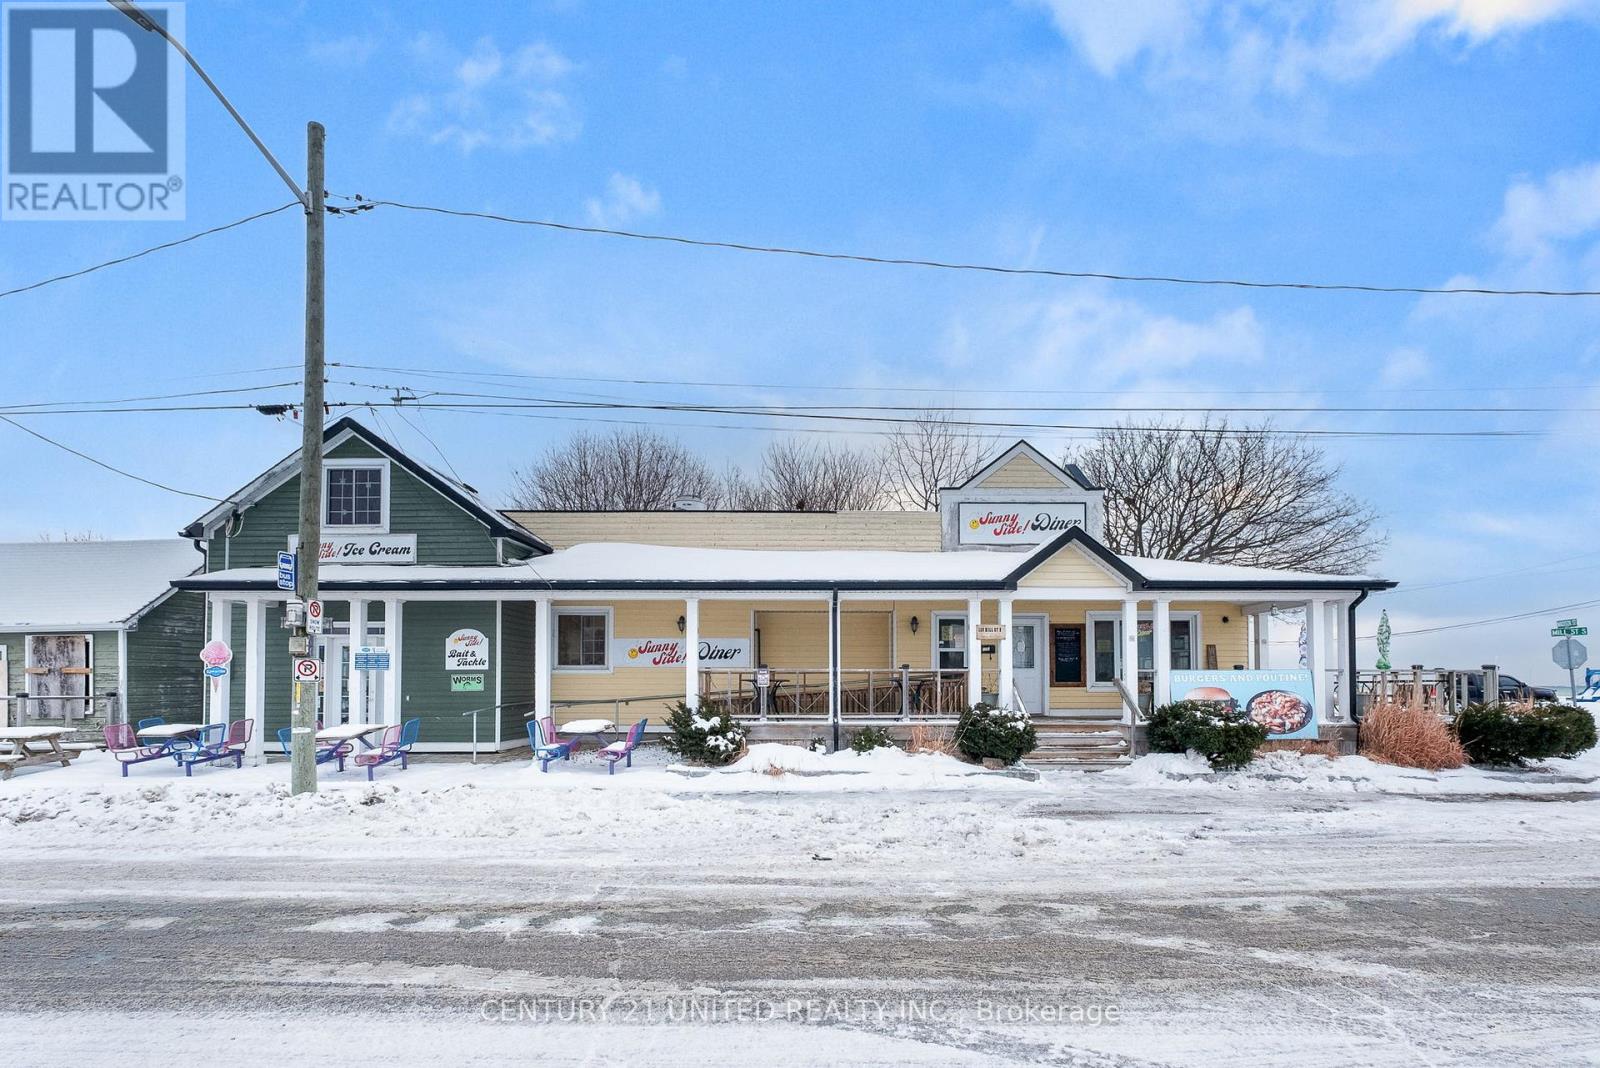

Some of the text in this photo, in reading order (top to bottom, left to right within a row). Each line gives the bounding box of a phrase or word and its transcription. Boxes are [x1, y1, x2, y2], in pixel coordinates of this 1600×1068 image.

[979, 511, 1019, 527] Sunny
[993, 512, 1082, 537] Side! Diner
[343, 542, 364, 557] Ice
[368, 541, 411, 556] Cream
[280, 572, 291, 580] bus
[280, 579, 294, 588] stop
[638, 640, 679, 656] Sunny
[698, 641, 742, 661] Diner
[448, 649, 476, 658] Bait &
[456, 658, 487, 667] Tackle
[452, 676, 482, 685] WORMS
[1174, 674, 1225, 683] BURGERS
[1231, 674, 1253, 682] AND
